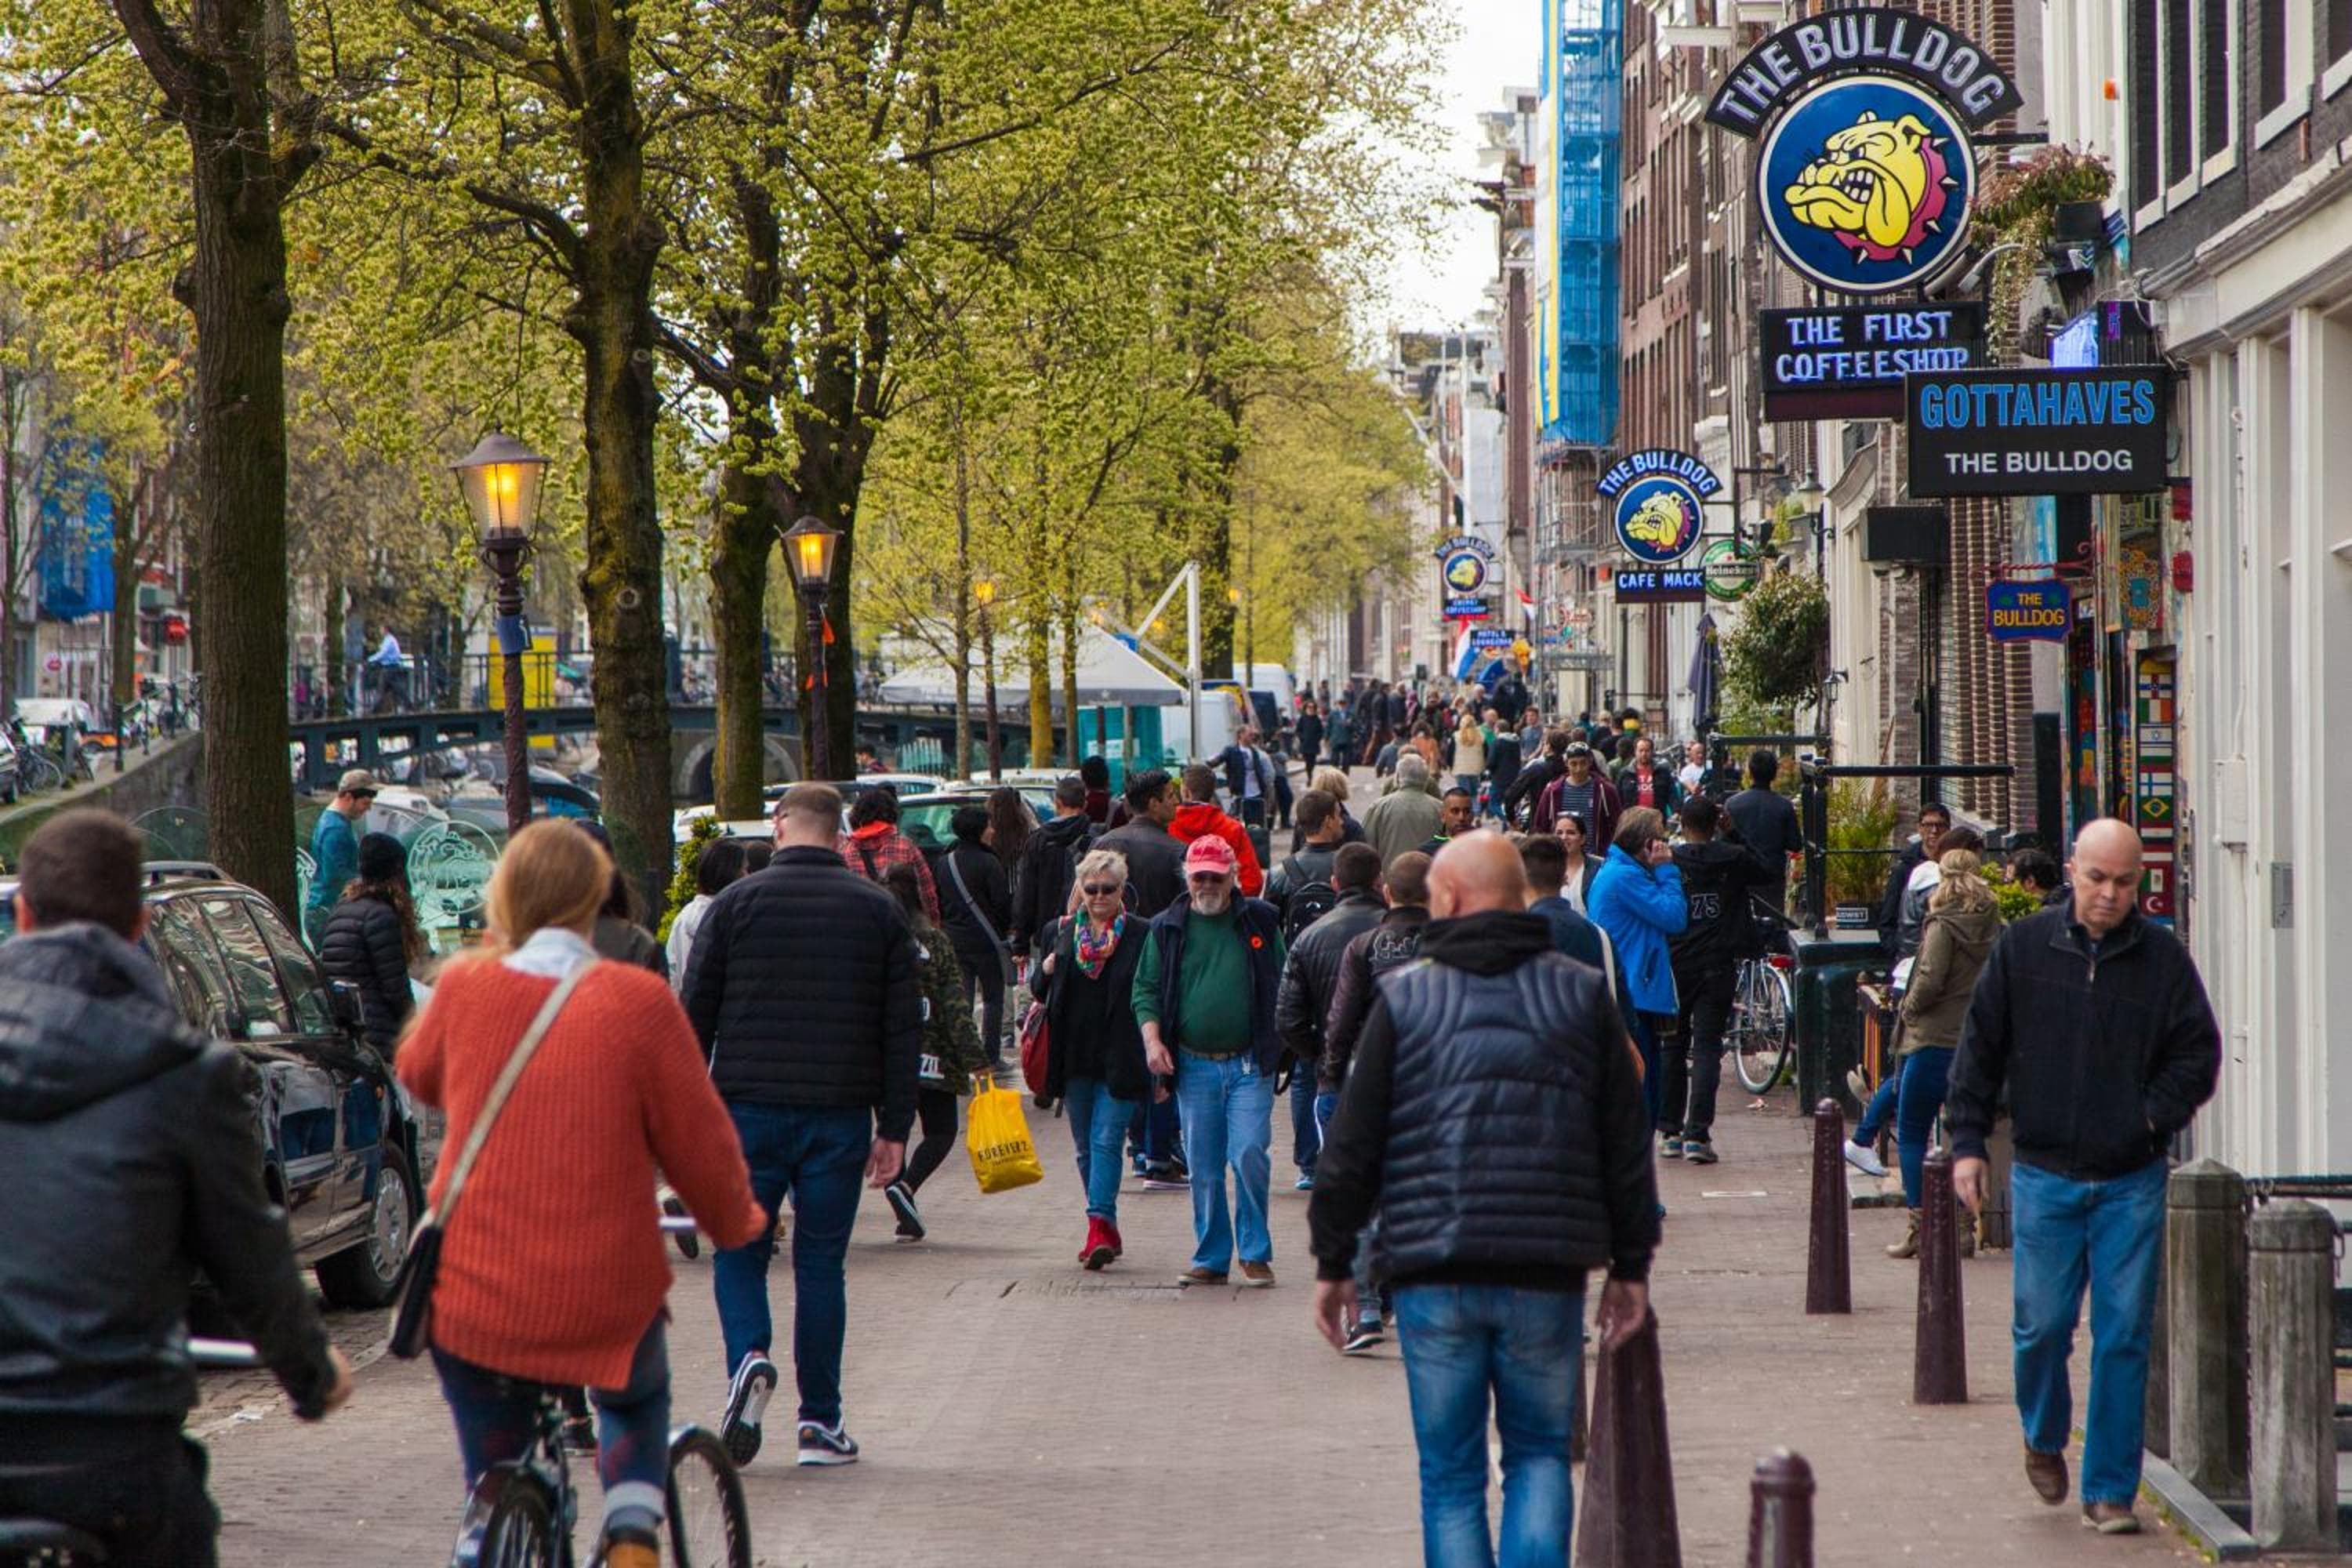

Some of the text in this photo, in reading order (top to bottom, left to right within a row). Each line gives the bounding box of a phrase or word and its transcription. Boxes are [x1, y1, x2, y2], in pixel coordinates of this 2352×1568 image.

[1717, 15, 2005, 122] THE BULLDOG
[1786, 310, 1952, 346] THE FIRST
[1776, 347, 1969, 383] COFFEESHOP
[1921, 379, 2155, 429] GOTTAHAVES
[1599, 451, 1717, 495] THE BULLDOG
[1944, 449, 2132, 474] THE BULLDOG
[1618, 572, 1703, 588] CAFE MACK
[2017, 593, 2042, 605] THE
[1994, 608, 2065, 626] BULLDOG
[1691, 893, 1720, 920] 75
